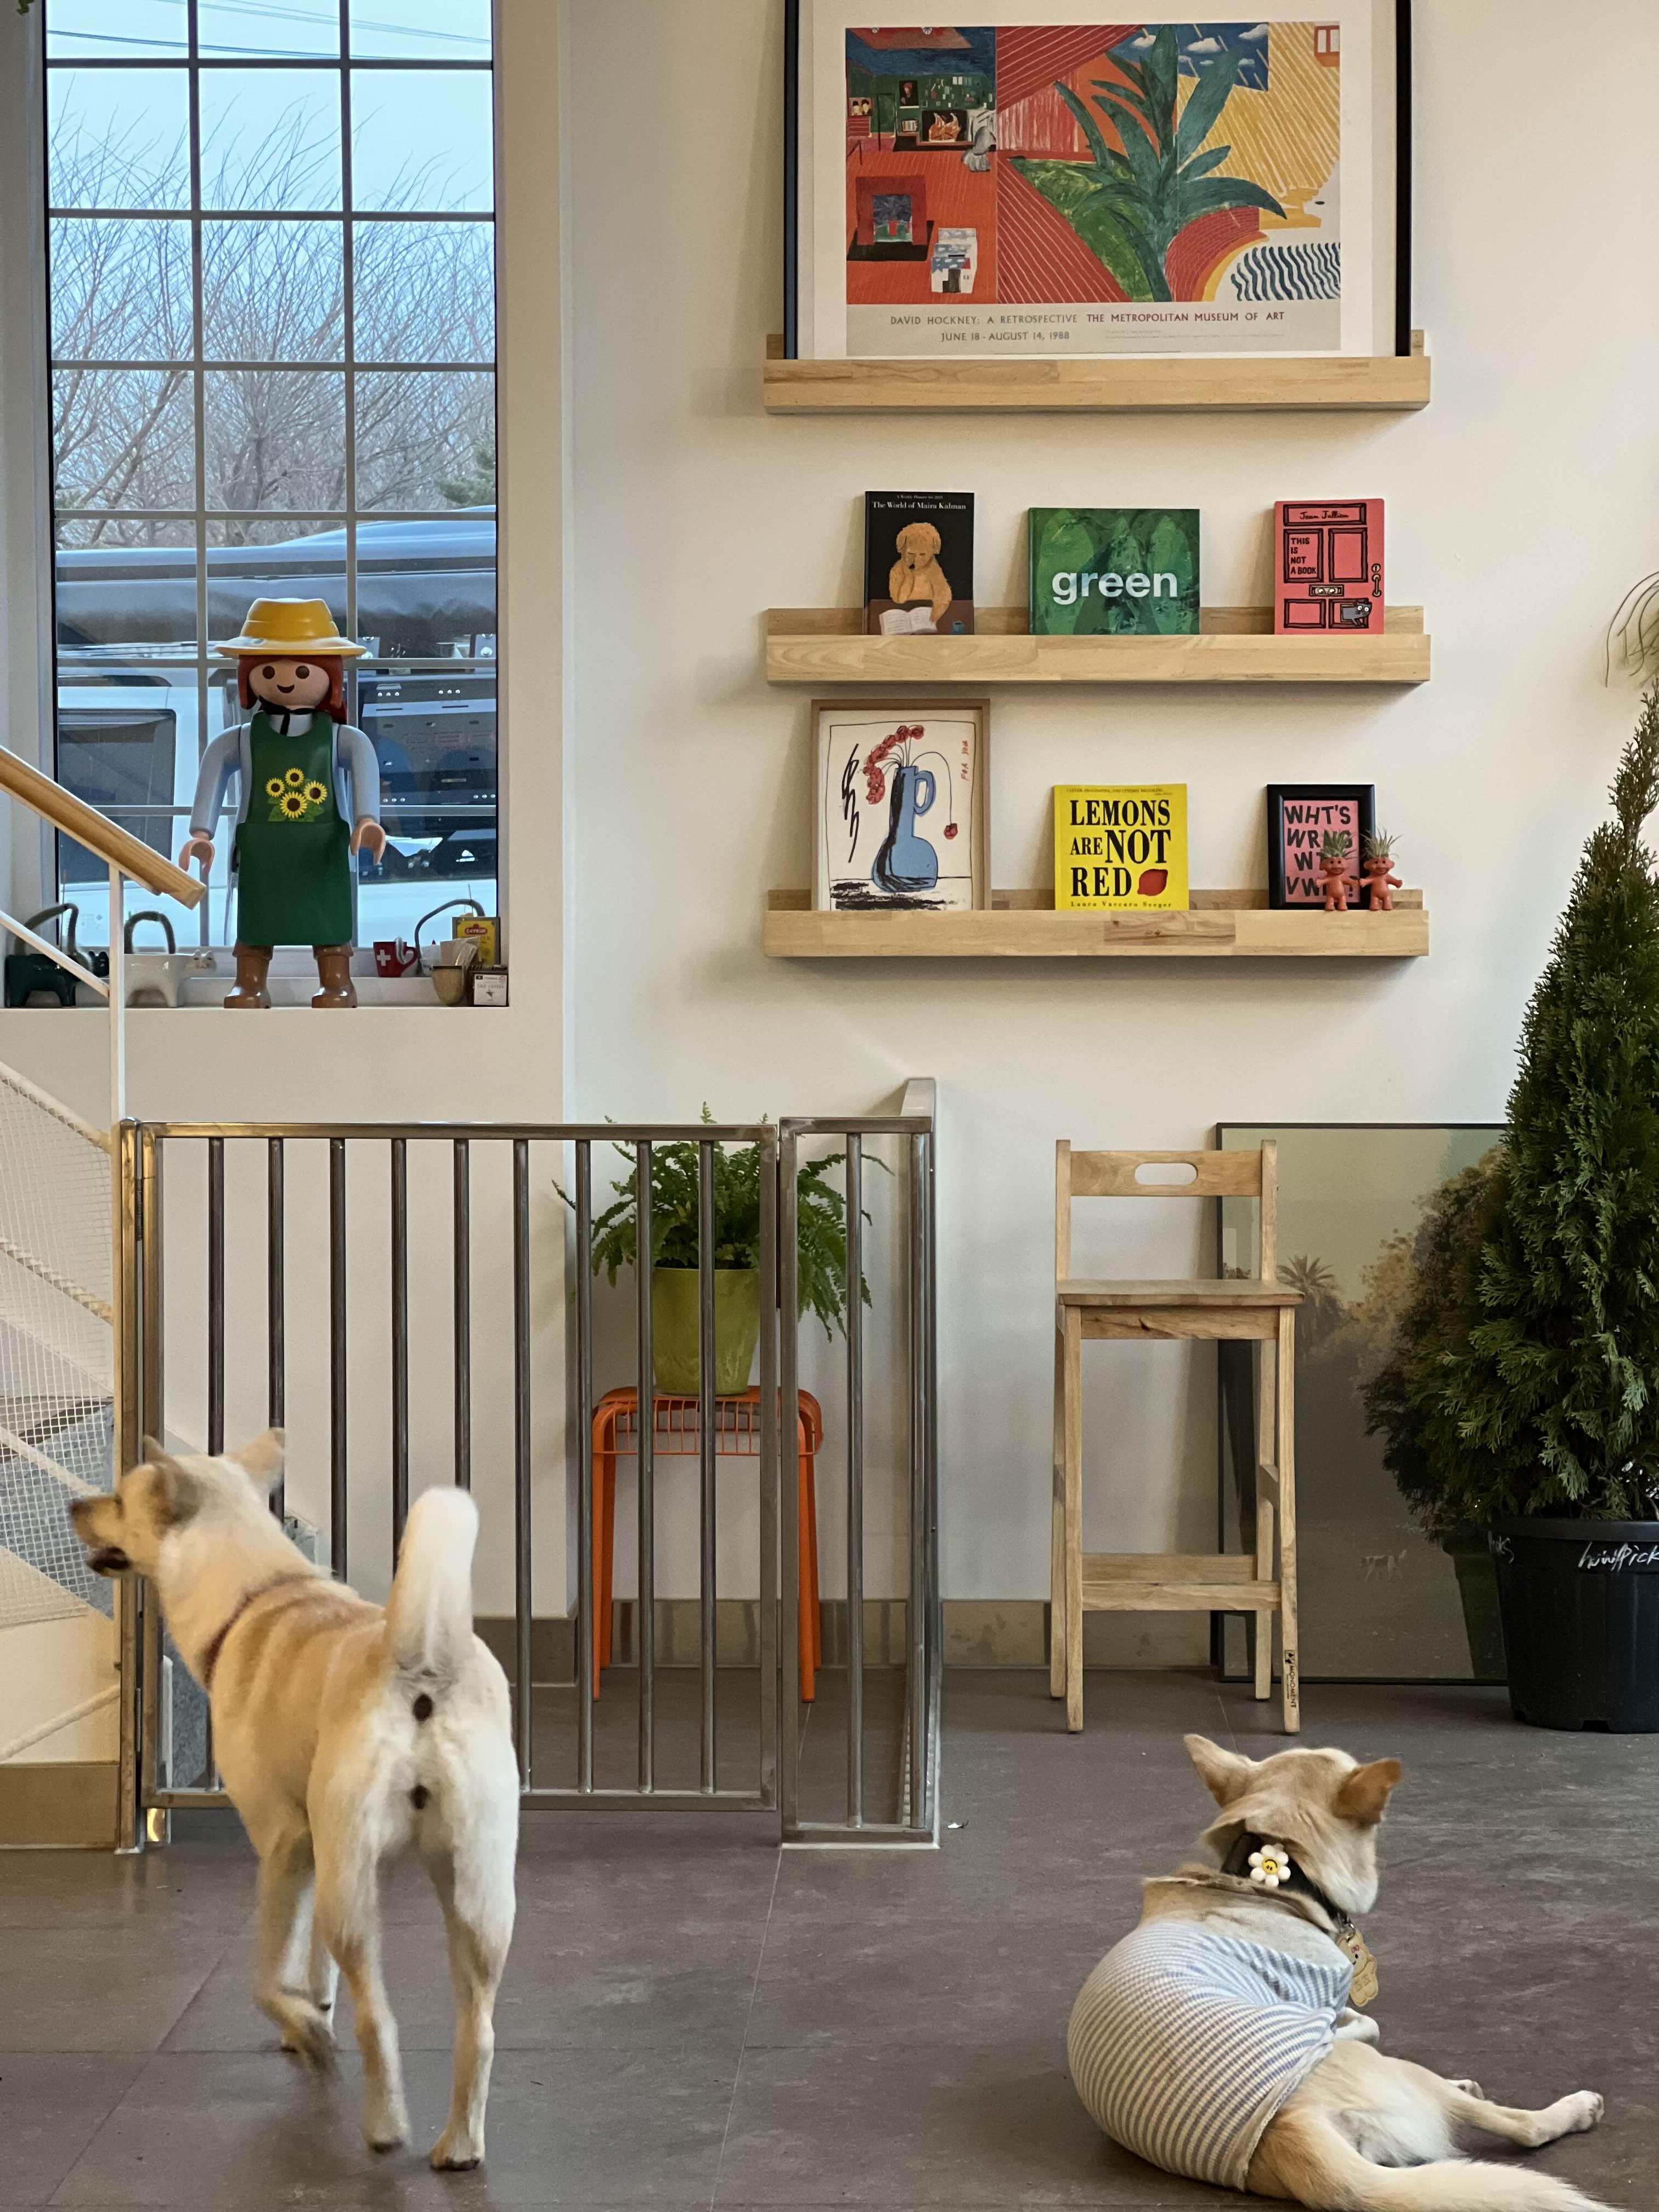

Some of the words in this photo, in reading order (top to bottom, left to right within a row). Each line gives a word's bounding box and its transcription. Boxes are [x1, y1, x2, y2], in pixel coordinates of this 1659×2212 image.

[890, 316, 921, 325] DAVID
[927, 316, 980, 325] HOCKNEY:
[987, 316, 994, 324] A
[1000, 314, 1077, 324] RETROSPECTIVE
[1087, 314, 1104, 323] THE
[1111, 313, 1188, 323] METROPOLITAN
[1194, 312, 1238, 321] MUSEUM
[1245, 312, 1258, 321] OF
[1266, 312, 1285, 320] ART
[941, 332, 966, 342] JUNE
[971, 332, 980, 341] 18
[989, 331, 1029, 341] AUGUST
[1033, 332, 1045, 341] 14,
[1049, 331, 1070, 340] 1988
[1290, 556, 1306, 564] NOT
[1290, 566, 1296, 574] A
[1297, 566, 1317, 574] BOOK
[1052, 572, 1177, 605] green
[1070, 799, 1170, 826] LEMONS
[1284, 805, 1351, 825] WHT'S
[1070, 837, 1103, 855] ARE
[1104, 829, 1171, 864] NOT
[1071, 867, 1132, 896] RED
